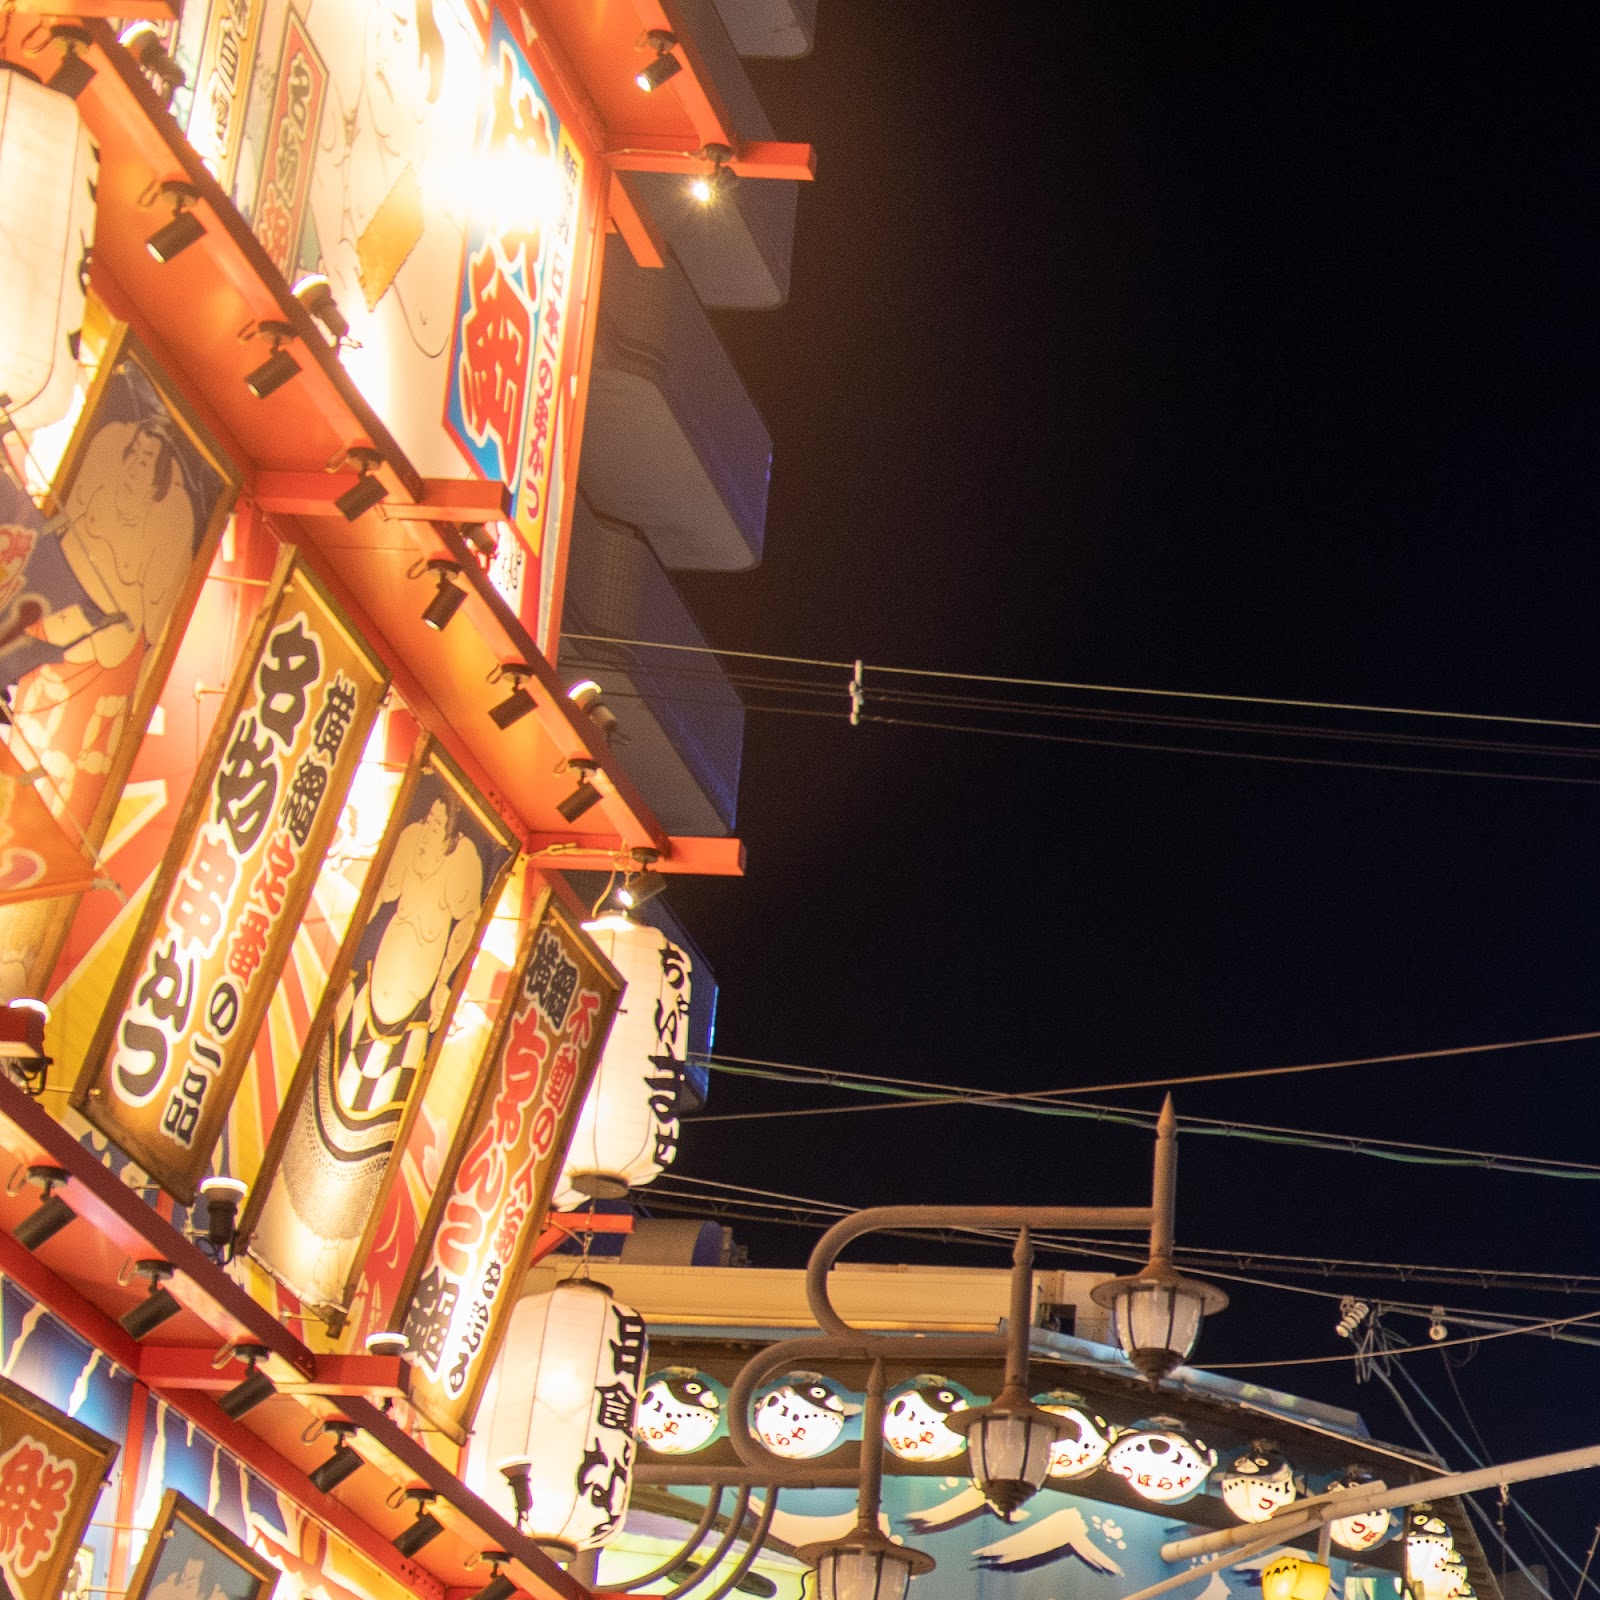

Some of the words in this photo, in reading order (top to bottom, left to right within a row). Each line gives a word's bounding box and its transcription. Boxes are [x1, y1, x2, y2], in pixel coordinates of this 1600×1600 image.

[114, 620, 320, 1100] 名物串かつ
